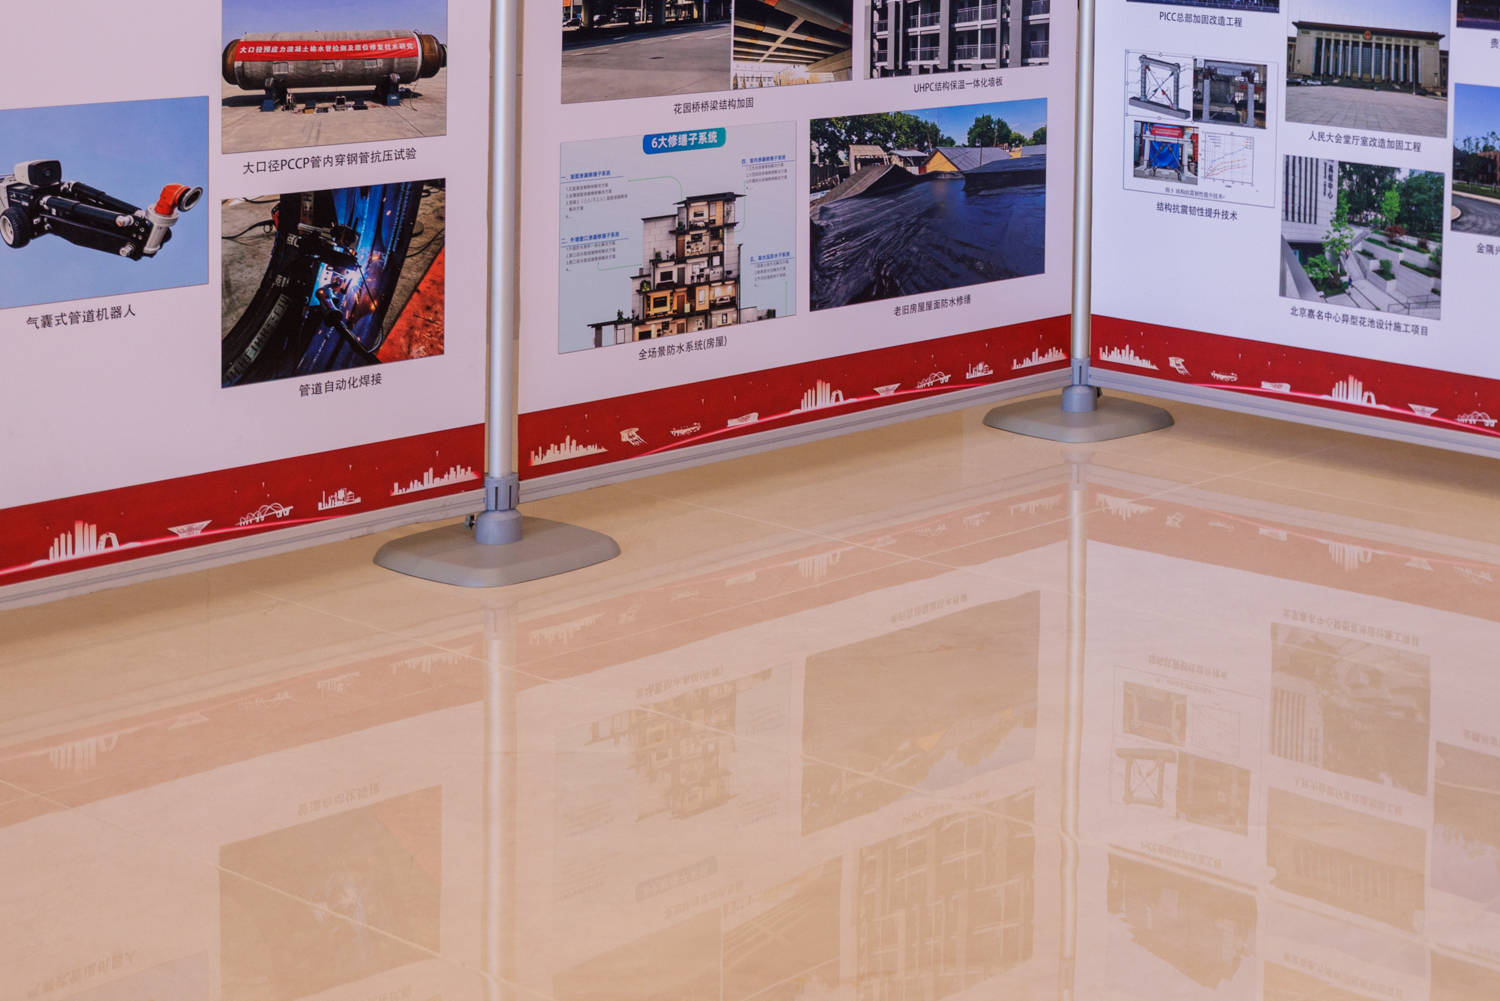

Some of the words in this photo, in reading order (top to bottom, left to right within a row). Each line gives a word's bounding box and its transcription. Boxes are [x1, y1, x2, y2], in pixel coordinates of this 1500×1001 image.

[1159, 11, 1243, 28] PICC总部加固改造工程
[913, 76, 1004, 94] UHPC结构保温一体化墙板
[673, 97, 754, 115] 花园桥桥梁结构加固
[651, 130, 718, 149] 6大修缮子系统
[1308, 131, 1422, 153] 人民大会堂厅室改造加固工程
[243, 147, 417, 176] 大口径PCCP管内穿钢管抗压试验
[1156, 202, 1238, 221] 结构抗震韧性提升技术
[893, 294, 972, 317] 老旧房屋屋面防水修缮
[26, 304, 136, 331] 气囊式管道机器人
[299, 373, 382, 397] 管道自动化焊接
